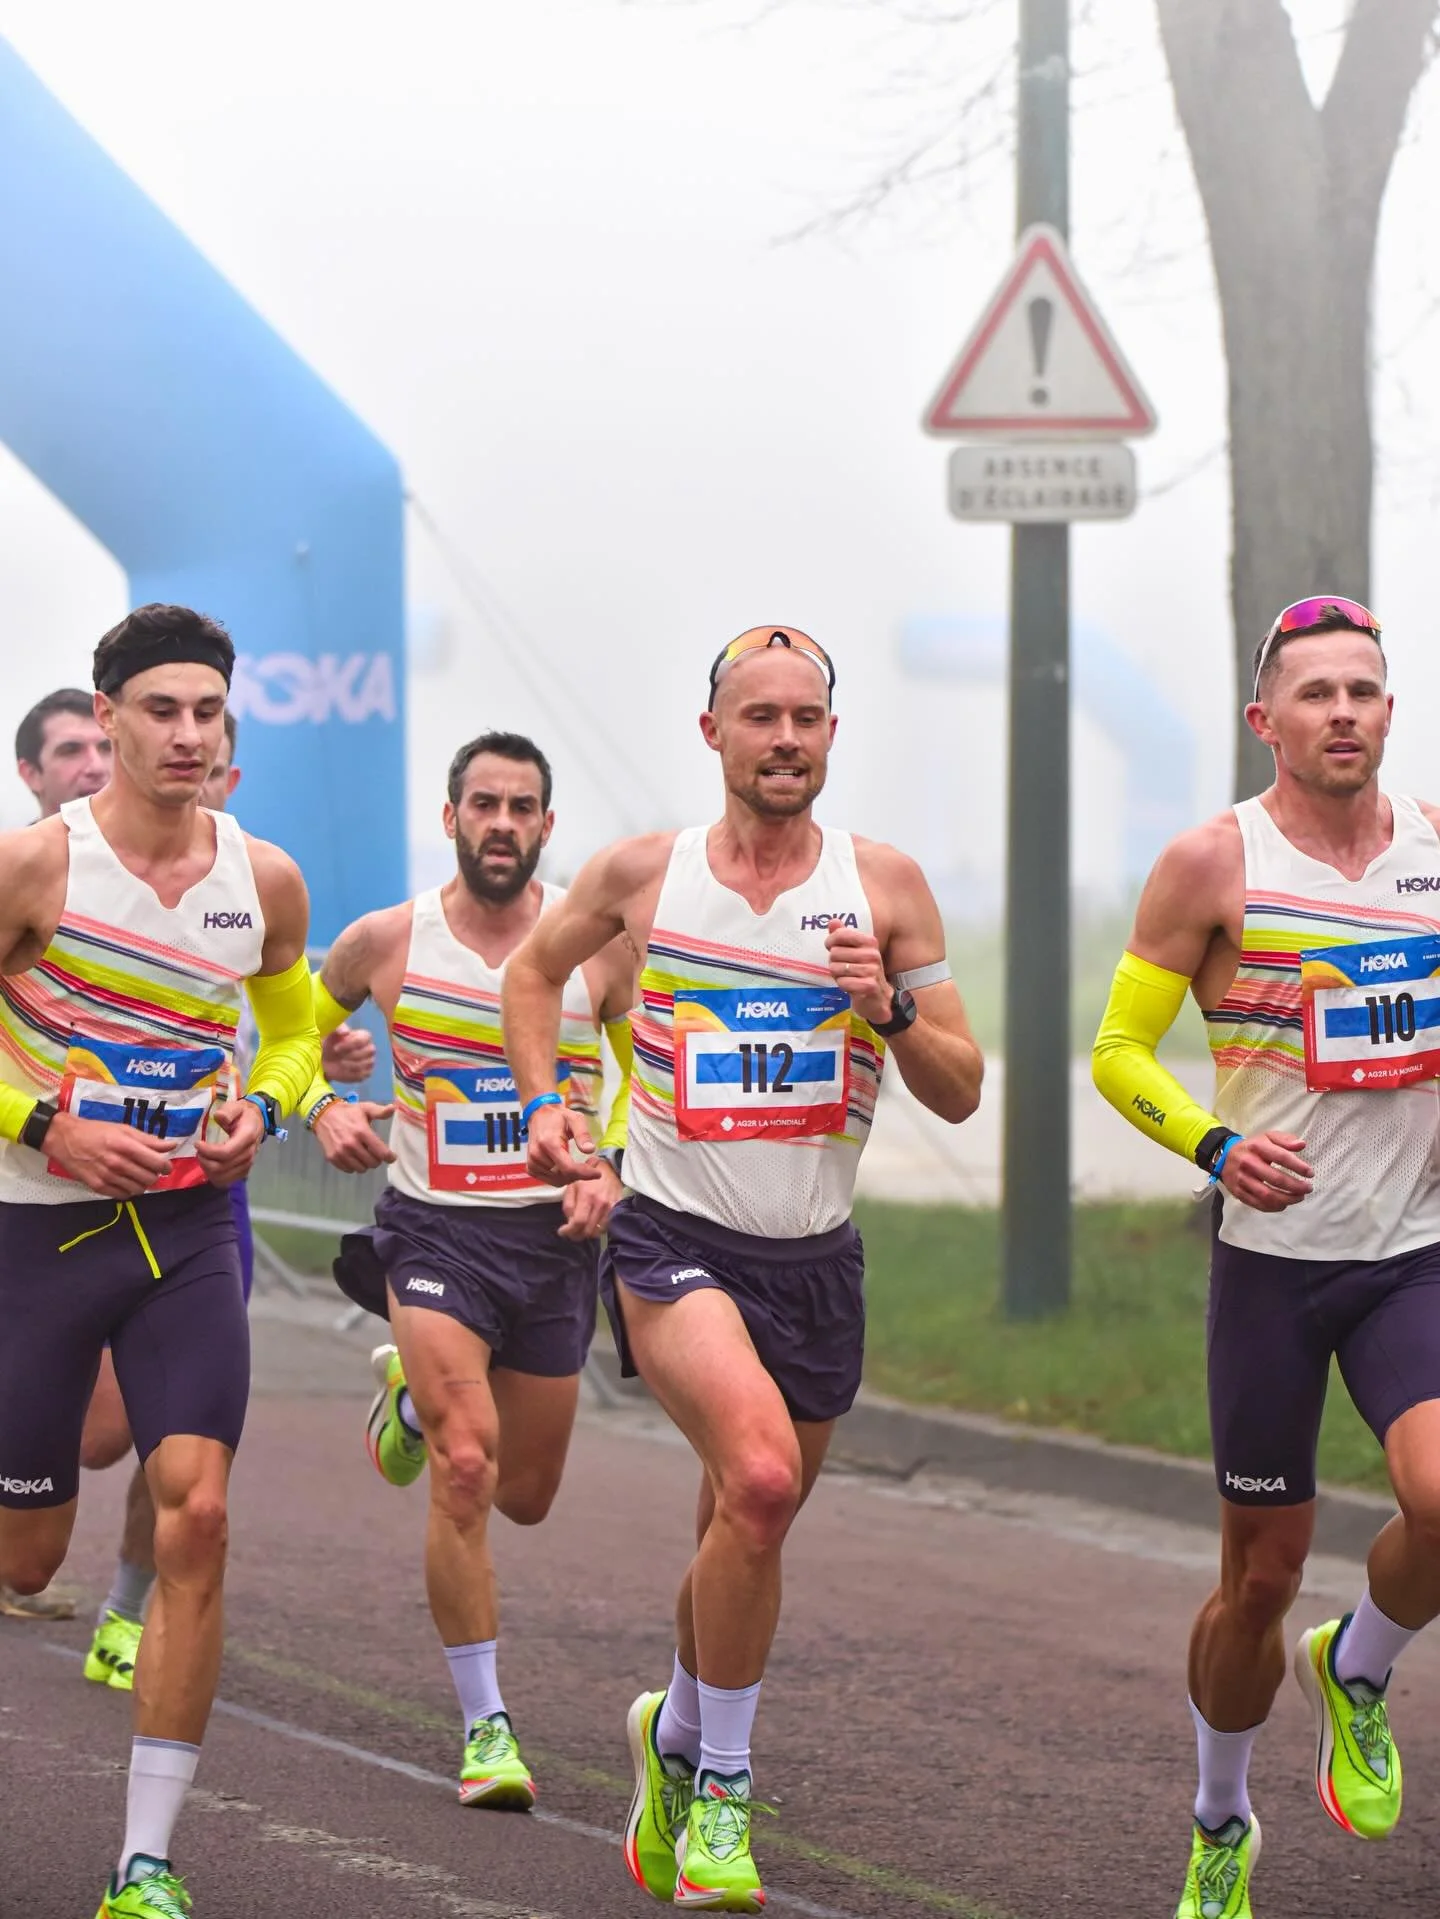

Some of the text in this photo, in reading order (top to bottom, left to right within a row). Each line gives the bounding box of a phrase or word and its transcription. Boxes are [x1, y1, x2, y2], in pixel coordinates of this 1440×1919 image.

[203, 912, 252, 928] HOKA
[1359, 952, 1408, 972] HOKA
[736, 1001, 790, 1018] HOKA
[1365, 993, 1416, 1045] 110
[126, 1058, 176, 1078] HOKA
[739, 1043, 793, 1093] 112
[1367, 1070, 1388, 1078] AG2R
[1388, 1069, 1399, 1077] LA
[1132, 1094, 1166, 1127] HOKA
[484, 1111, 520, 1153] 111
[736, 1118, 807, 1128] AG2R LA MONDIALE
[406, 1277, 444, 1296] HOKA
[1226, 1471, 1286, 1492] HOKA
